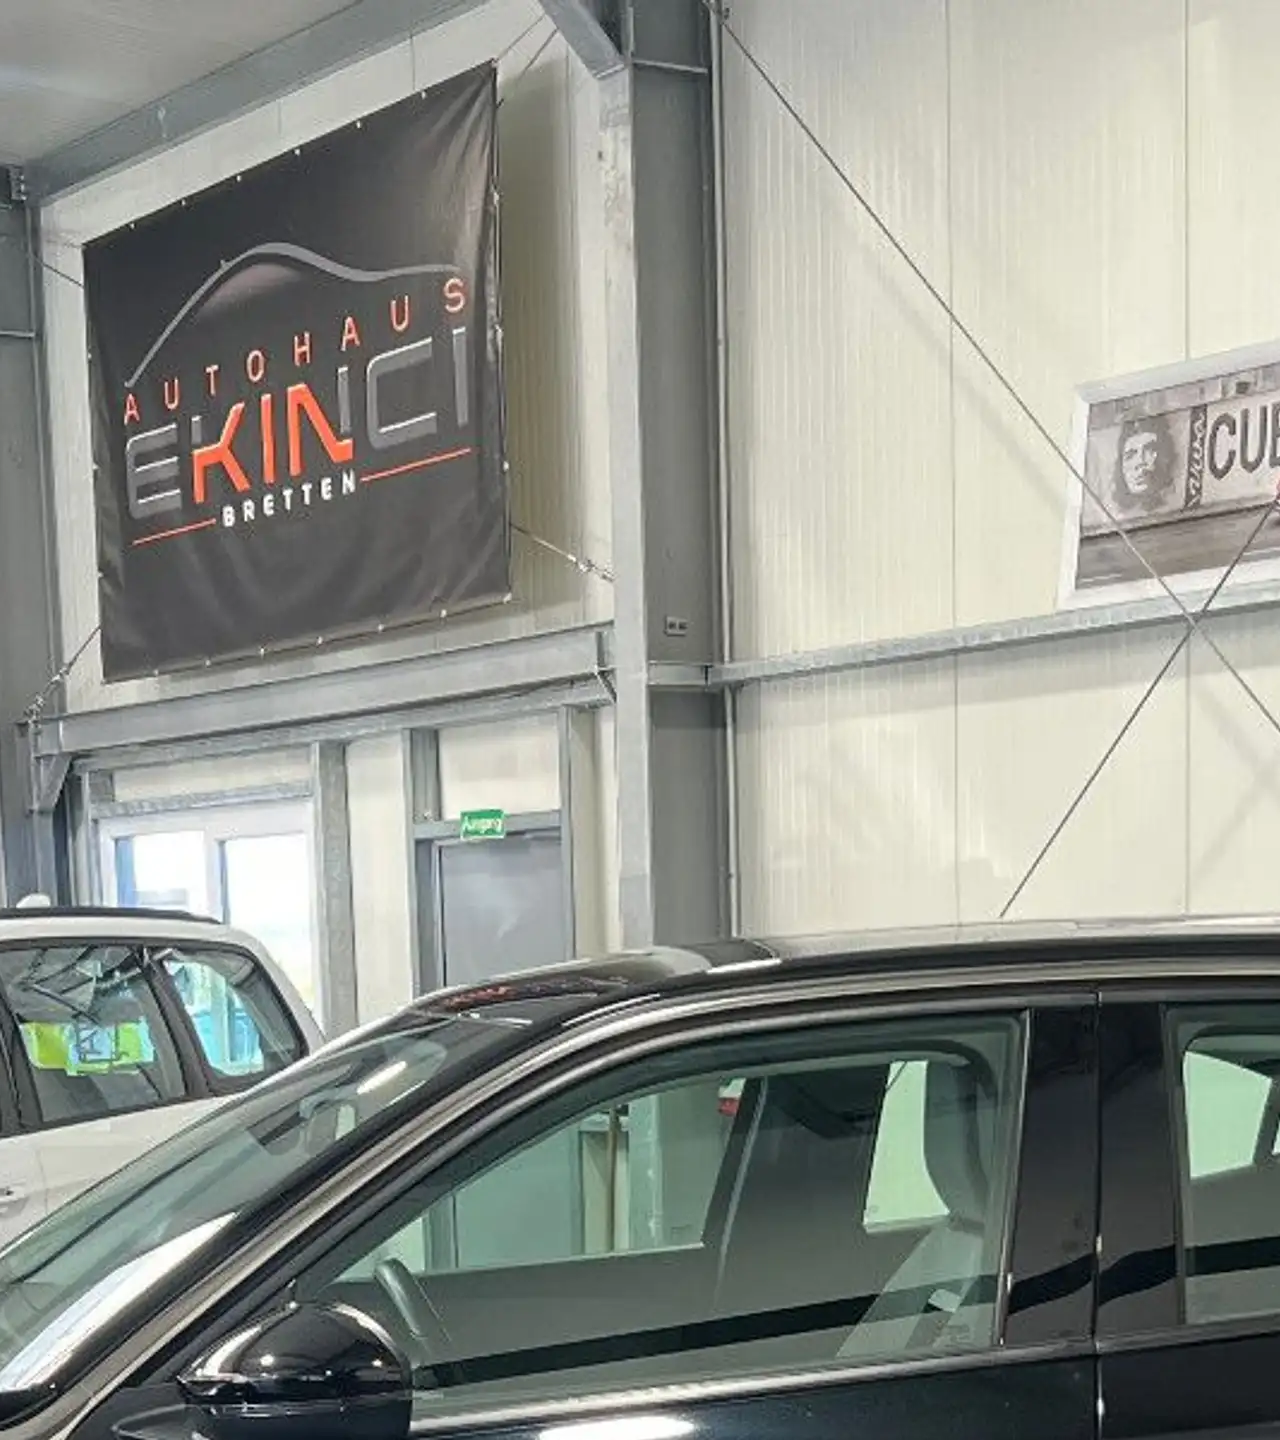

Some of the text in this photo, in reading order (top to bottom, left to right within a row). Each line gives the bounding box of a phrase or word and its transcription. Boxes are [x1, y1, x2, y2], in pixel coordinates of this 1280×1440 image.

[124, 276, 467, 426] AUTOHAUS
[125, 326, 469, 520] EKINCI
[222, 469, 357, 528] BRETTEN
